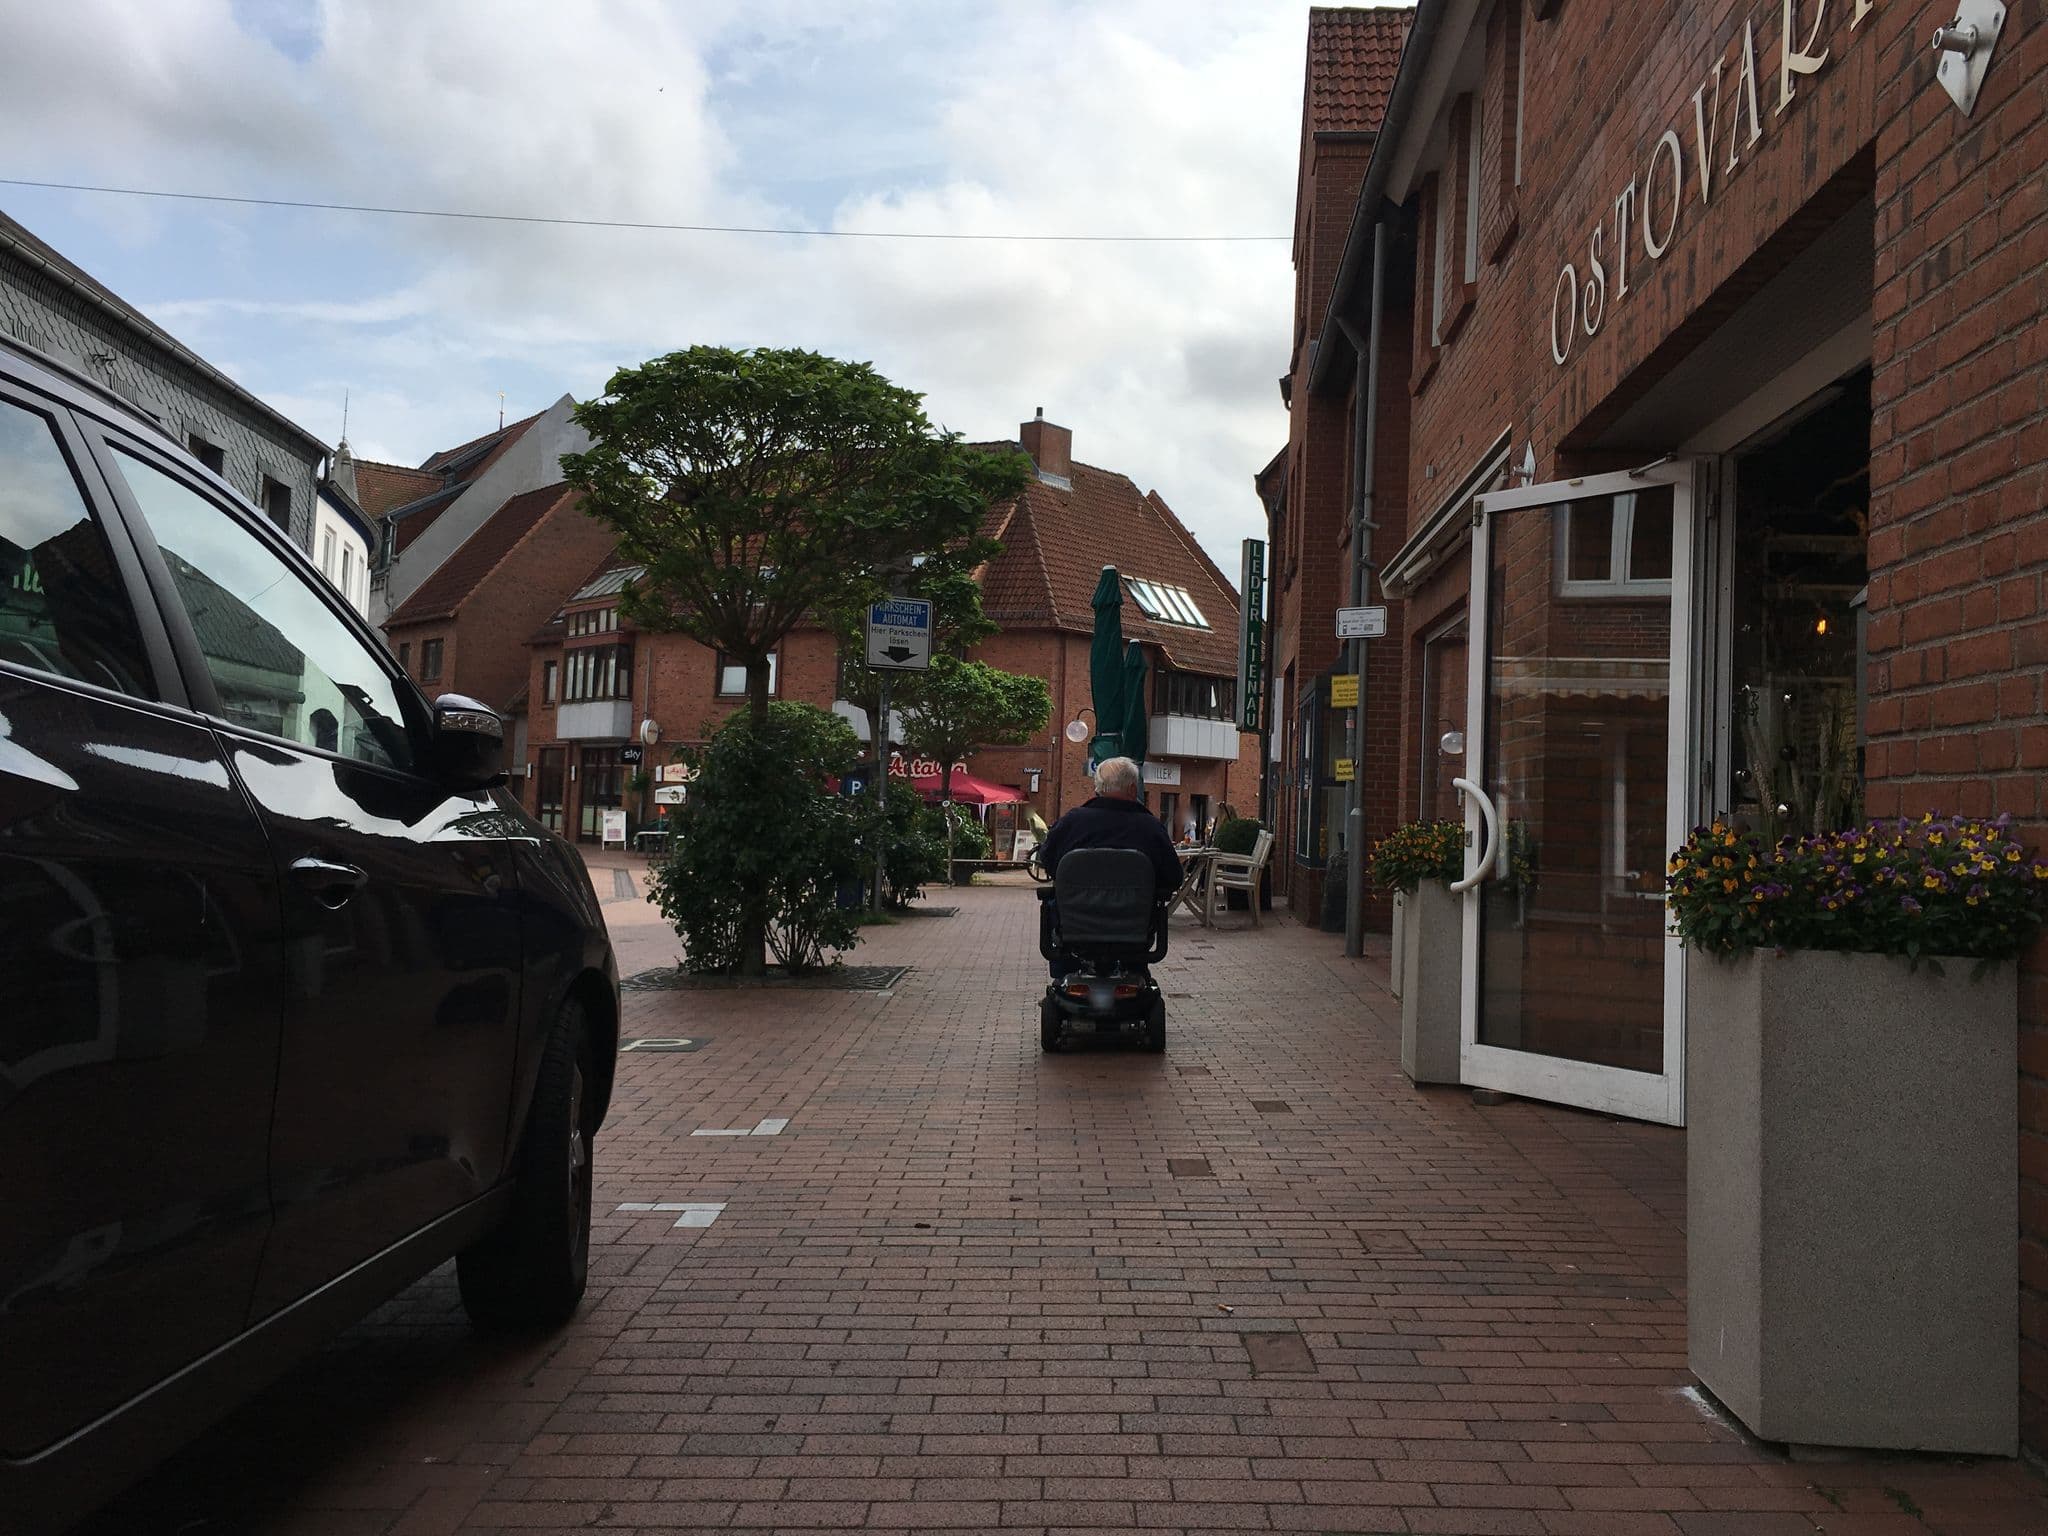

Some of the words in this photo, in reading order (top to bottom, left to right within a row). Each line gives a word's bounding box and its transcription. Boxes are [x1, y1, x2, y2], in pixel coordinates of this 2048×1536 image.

[1551, 0, 1873, 366] OSTOVAR
[1250, 543, 1261, 622] LEDER
[883, 613, 918, 626] AUTOMAT
[871, 626, 886, 635] Hier
[889, 627, 928, 638] Parkschein
[889, 636, 909, 645] lösen
[1246, 632, 1258, 727] LIENAU
[624, 750, 641, 760] sky
[851, 780, 862, 796] P
